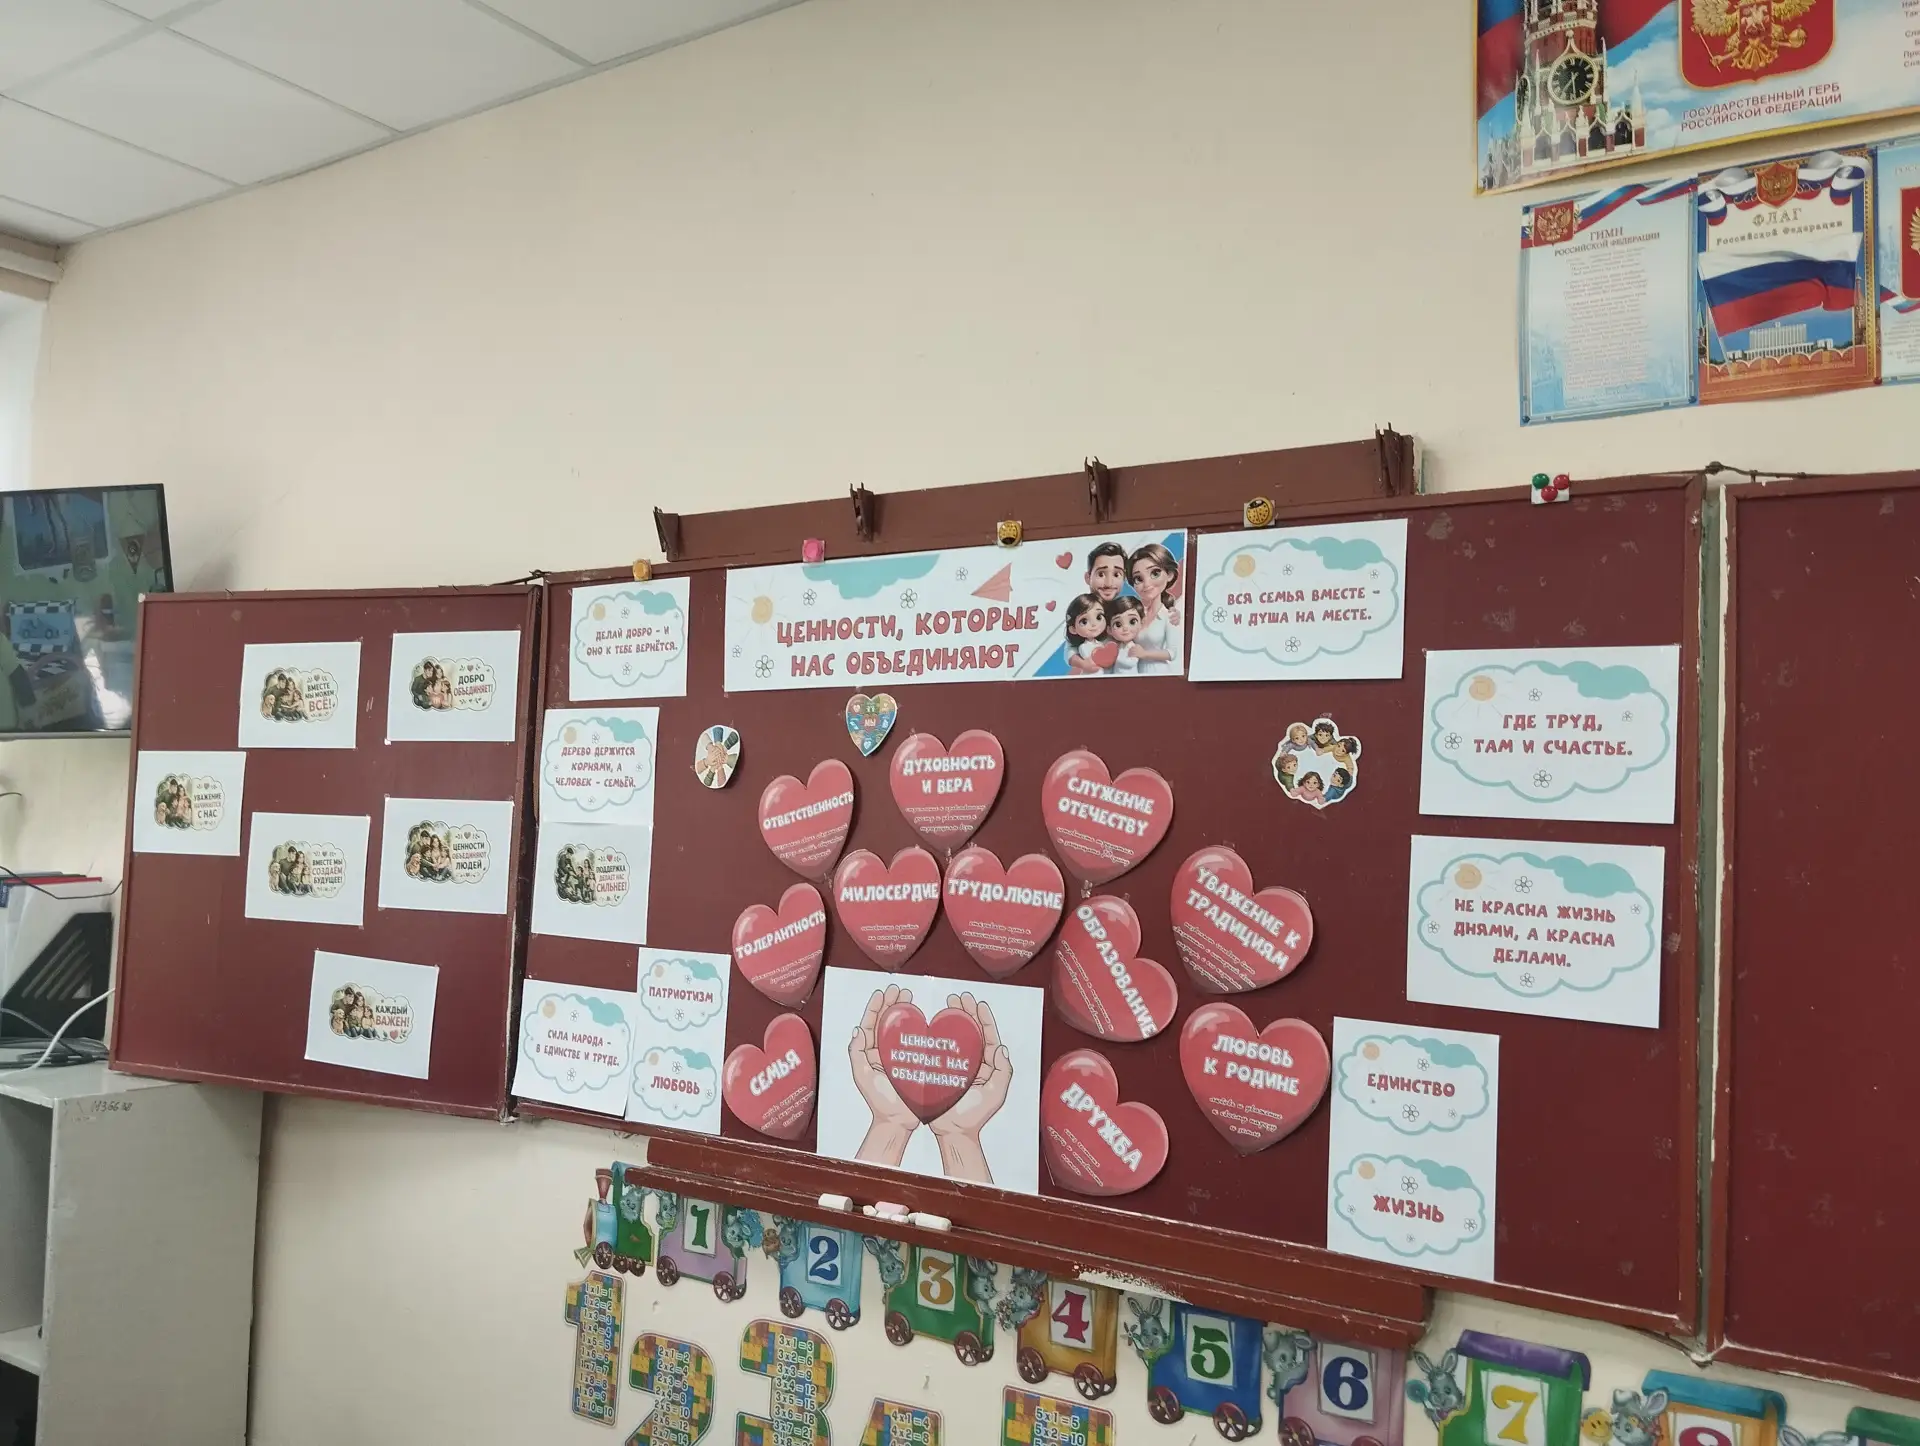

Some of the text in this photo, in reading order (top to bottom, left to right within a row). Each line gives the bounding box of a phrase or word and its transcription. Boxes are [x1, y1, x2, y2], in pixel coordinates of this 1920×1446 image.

[1681, 94, 1842, 132] РОССИЙСКОЙ ФЕДЕРАЦИИ
[1683, 82, 1840, 120] ГОСУДАРСТВЕННЫЙ ГЕРБ
[1752, 207, 1802, 226] ФЛАГ
[1554, 232, 1660, 257] РОССИЙСКОЙ ФЕДЕРАЦИИ
[1590, 227, 1623, 240] ГИМН
[1716, 220, 1843, 246] Российской Федерации
[1227, 592, 1253, 605] ВСЯ
[1259, 589, 1305, 603] СЕМЬЯ
[1311, 587, 1365, 602] ВМЕСТЕ
[777, 605, 1040, 647] ЦЕННОСТИ, КОТОРЫЕ
[1233, 608, 1372, 627] И ДУША НА МЕСТЕ.
[596, 628, 622, 641] ДЕЛАЙ
[626, 627, 652, 639] ДОБРО
[664, 626, 669, 635] И
[586, 639, 678, 656] ОНО К ТЕБЕ ВЕРНЁТСЯ.
[791, 643, 1020, 677] НАС ОБЪЕДИНЯЮТ
[458, 674, 485, 685] ДОБРО
[1503, 714, 1603, 732] ГДЕ ТРУД,
[561, 747, 636, 757] ДЕРЕВО ДЕРЖИТСЯ
[1473, 739, 1633, 756] ТАМ И СЧАСТЬЕ.
[571, 762, 622, 773] КОРНЯМИ, А
[903, 755, 996, 776] ДУХОВНОСТЬ
[556, 776, 592, 787] ЧЕЛОВЕК
[604, 775, 636, 788] СЕМЬЁЙ.
[921, 777, 973, 794] И ВЕРА
[1067, 777, 1155, 815] СЛУЖЕНИЕ
[203, 809, 218, 818] НАС
[763, 791, 854, 830] ОТВЕТСТВЕННОСТЬ
[1058, 797, 1149, 836] ОТЕЧЕСТВУ
[452, 842, 485, 851] ЦЕННОСТИ
[456, 859, 482, 870] ЛЮДЕЙ
[840, 882, 939, 902] МИЛОСЕРДИЕ
[948, 878, 1063, 910] ТРУДОЛЮБИЕ
[1196, 866, 1301, 949] УВАЖЕНИЕ К
[1454, 898, 1616, 923] НЕ КРАСНА ЖИЗНЬ
[735, 910, 826, 959] ТОЛЕРАНТНОСТЬ
[1186, 888, 1289, 971] ТРАДИЦИЯМ
[1453, 921, 1616, 947] ДНЯМИ, А КРАСНА
[1493, 947, 1571, 968] ДЕЛАМИ.
[1076, 905, 1158, 1040] ОБРАЗОВАНИЕ
[649, 986, 714, 1003] ПАТРИОТИЗМ
[375, 1004, 408, 1015] КАЖДЫЙ
[375, 1015, 410, 1028] ВАЖЕН!
[547, 1029, 569, 1041] СИЛА
[571, 1032, 603, 1047] НАРОДА
[900, 1033, 960, 1054] ЦЕННОСТИ,
[536, 1043, 620, 1067] В ЕДИНСТВЕ И ТРУДЕ.
[890, 1049, 969, 1071] КОТОРЫЕ НАС
[1212, 1034, 1294, 1068] ЛЮБОВЬ
[749, 1049, 802, 1096] СЕМЬЯ
[891, 1067, 968, 1088] ОБЪЕДИНЯЮТ
[1203, 1057, 1299, 1096] К РОДИНЕ
[650, 1075, 700, 1095] ЛЮБОВЬ
[1367, 1073, 1456, 1097] ЕДИНСТВО
[1060, 1082, 1143, 1172] ДРУЖБА
[1373, 1194, 1445, 1223] ЖИЗНЬ
[691, 1204, 709, 1249] 1
[809, 1235, 839, 1281] 2
[919, 1256, 955, 1305] 3
[1051, 1289, 1090, 1344] 4
[1190, 1325, 1232, 1380] 5
[1322, 1356, 1369, 1410] 6
[1491, 1384, 1538, 1445] 7
